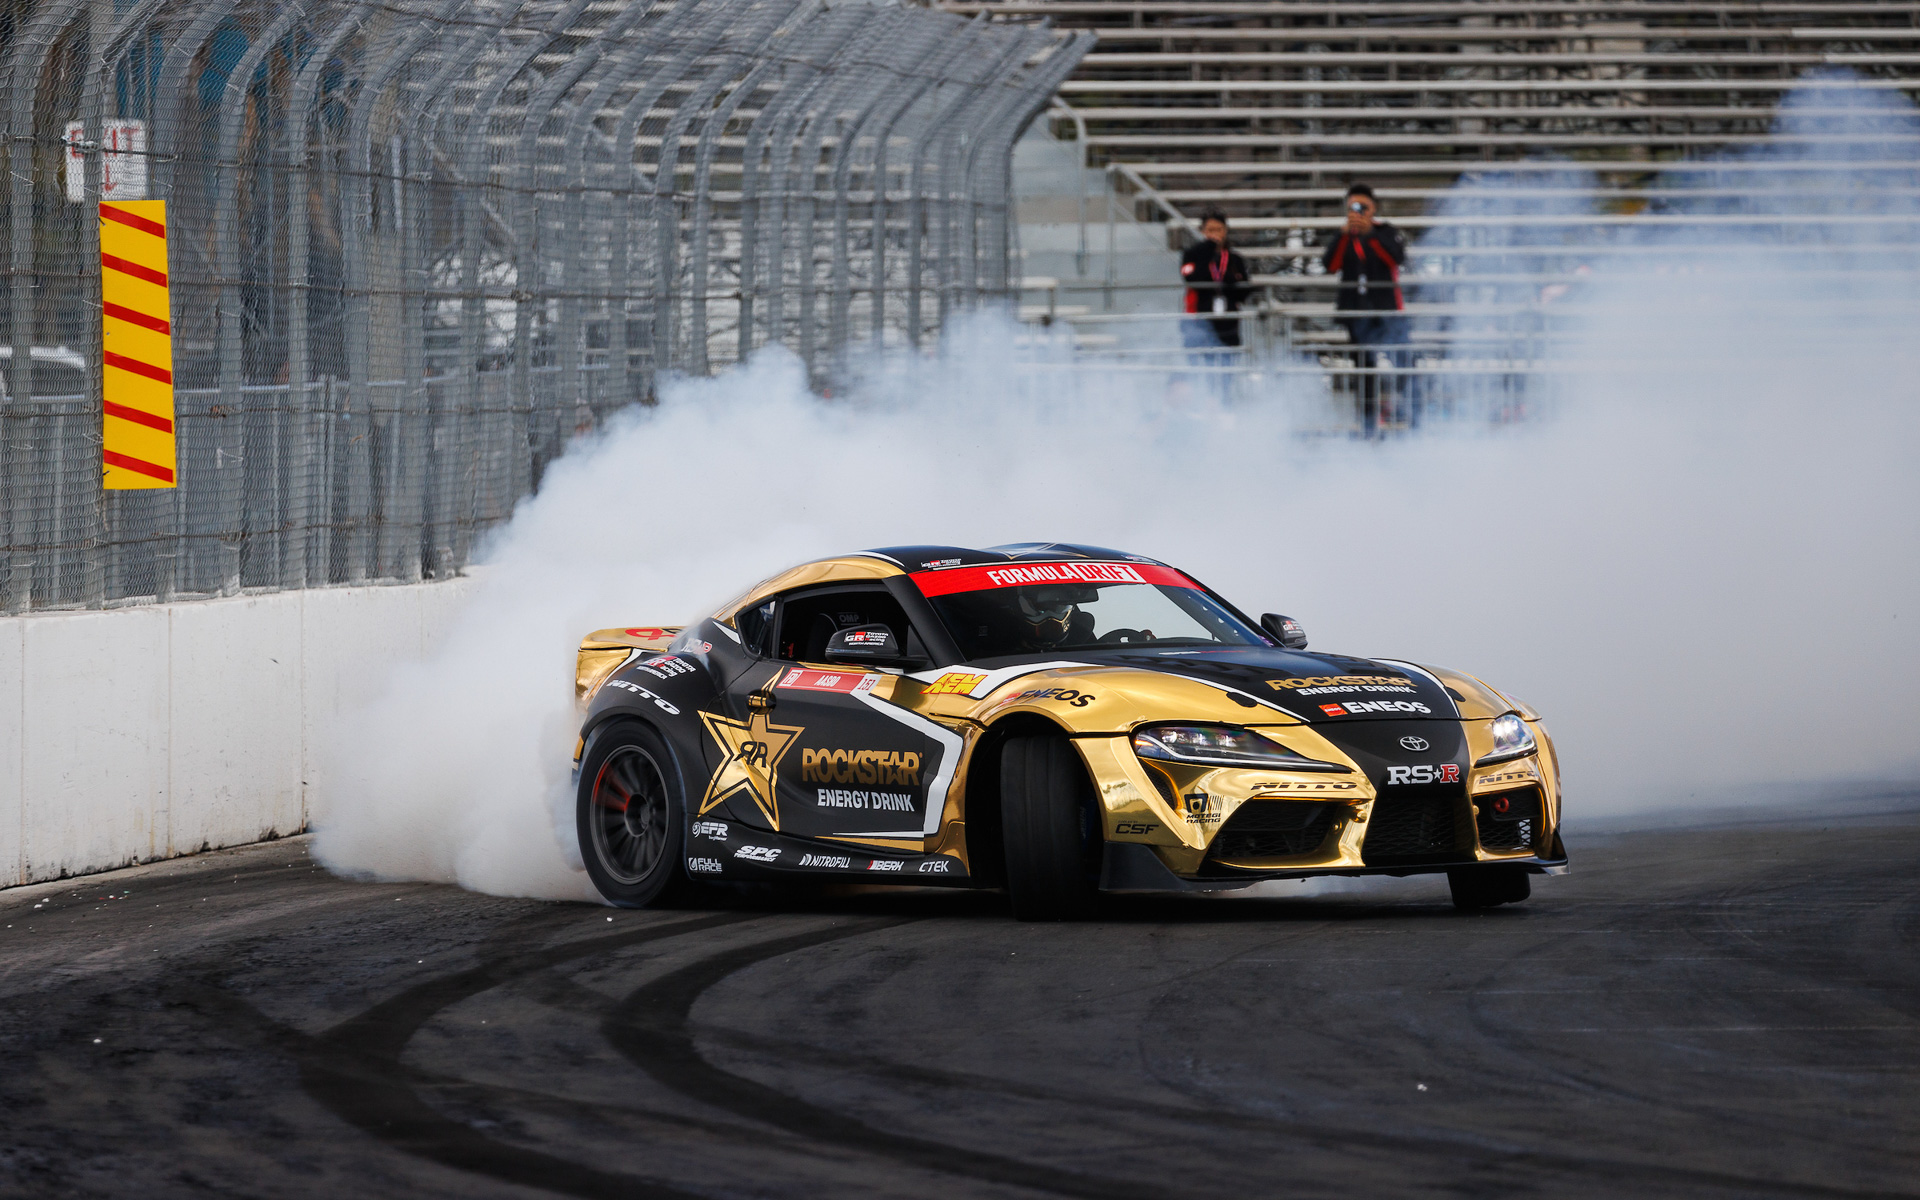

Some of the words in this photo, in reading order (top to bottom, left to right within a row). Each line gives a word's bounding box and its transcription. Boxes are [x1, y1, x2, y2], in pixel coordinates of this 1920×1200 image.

[71, 127, 140, 158] EIT
[986, 565, 1080, 586] FORMULA
[1071, 564, 1141, 582] DRIFT
[839, 614, 860, 623] OMP
[845, 634, 864, 642] GR
[1265, 675, 1418, 691] ROCKSTAR
[605, 679, 681, 715] NITTO
[1015, 687, 1096, 707] ENEOS
[1296, 685, 1362, 696] ENERGY
[1361, 685, 1417, 694] DRINK
[1341, 701, 1432, 714] ENEOS
[801, 747, 920, 786] ROCKSTAR
[1250, 781, 1358, 791] NITTO
[817, 788, 869, 809] ENERGY
[870, 791, 915, 812] DRINK
[700, 821, 729, 837] EFR
[1115, 824, 1160, 835] CSF
[736, 845, 782, 858] SPC
[697, 857, 719, 865] FULL
[810, 855, 851, 869] NITROFILL
[918, 860, 950, 872] CTEK
[698, 864, 723, 872] RACE
